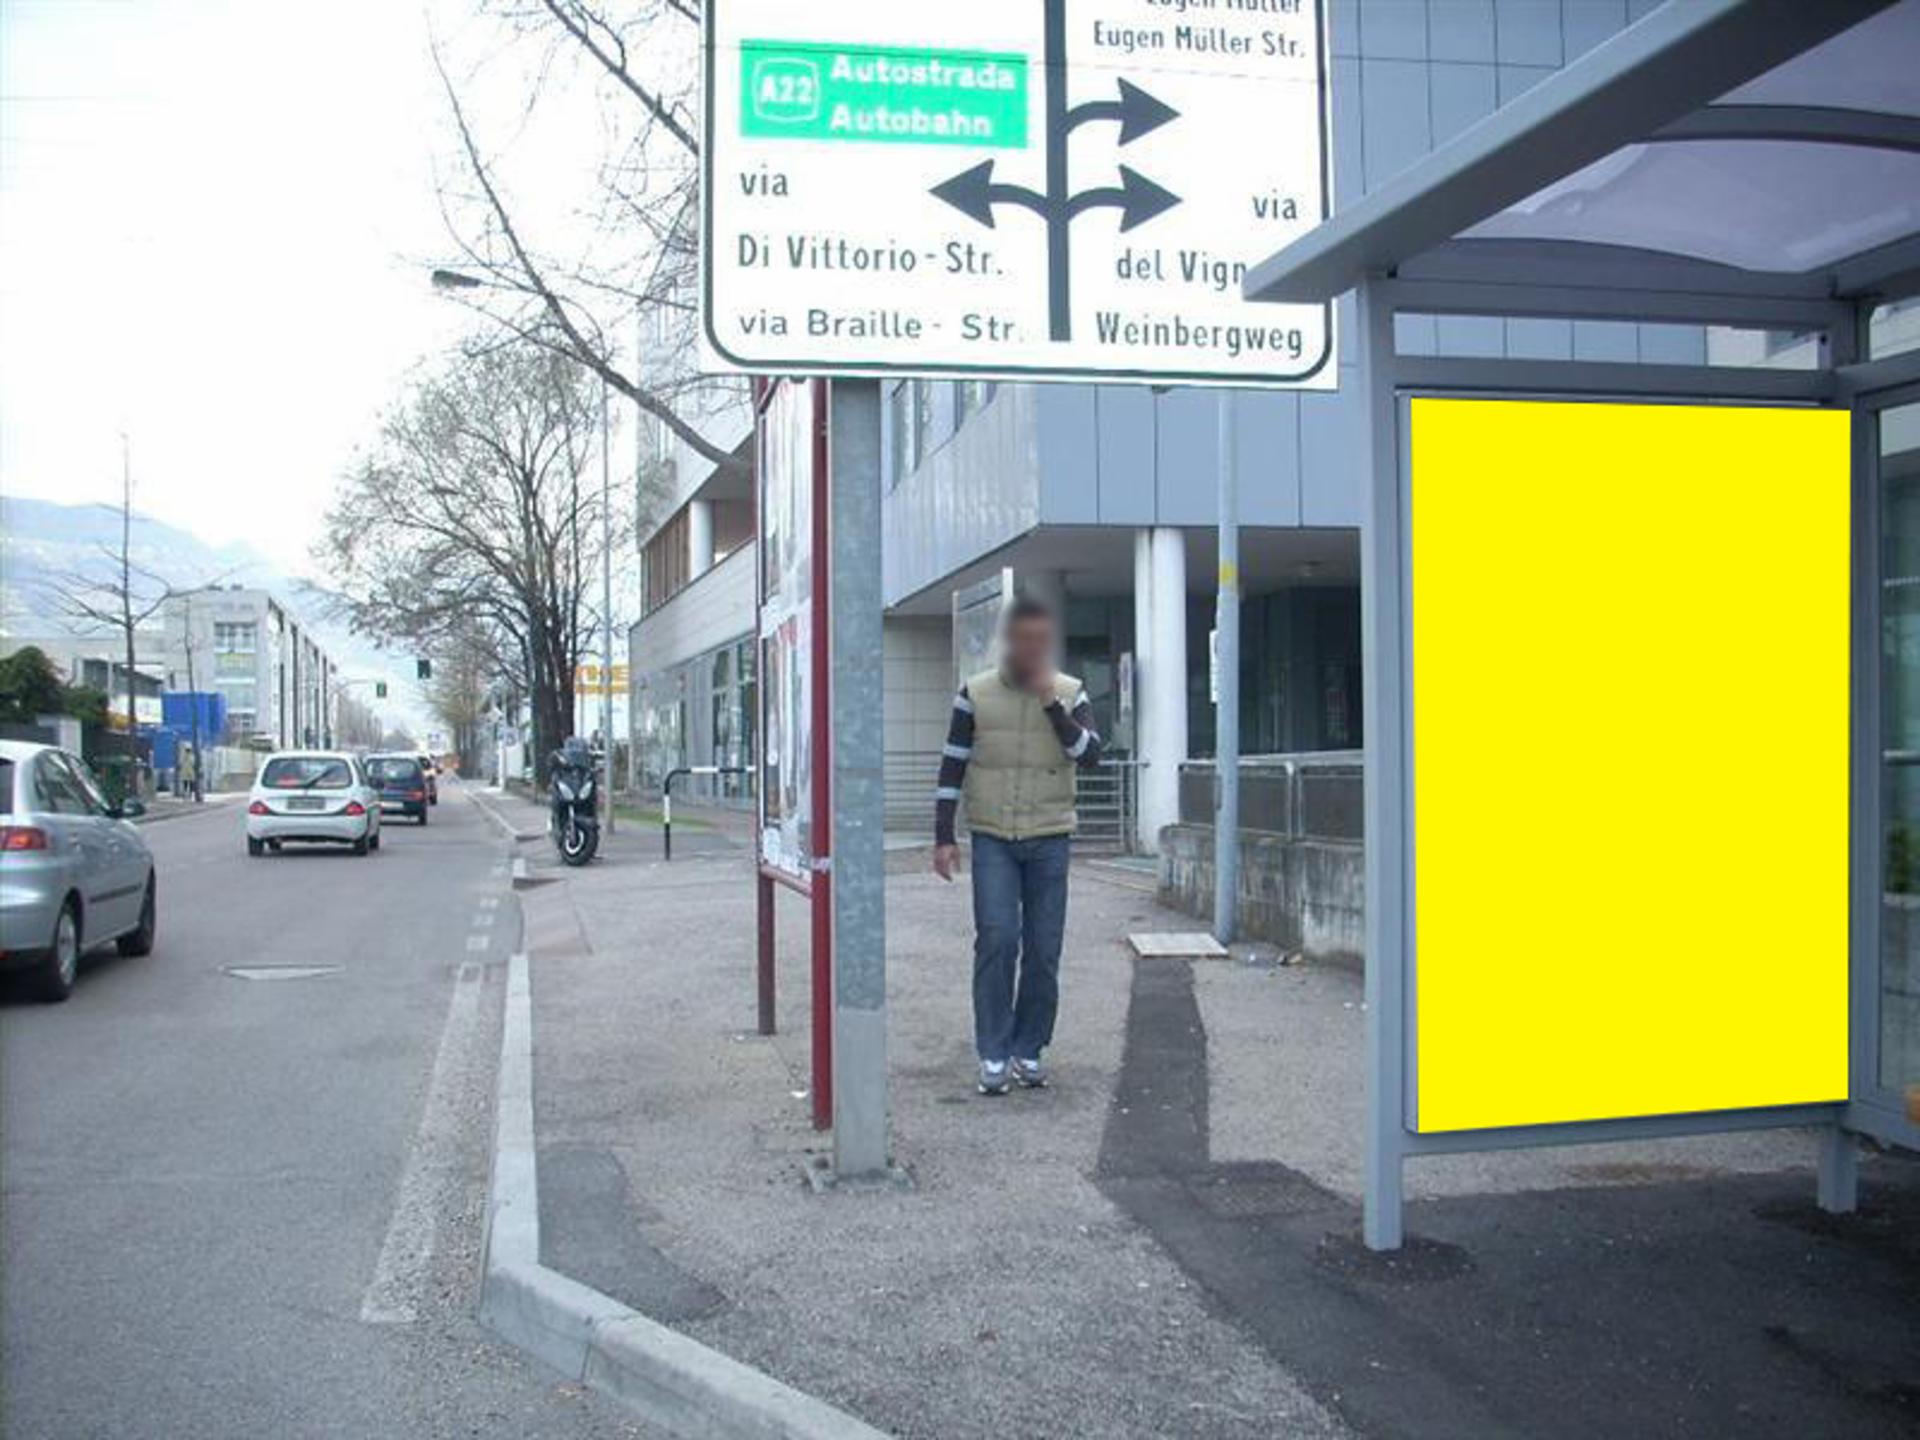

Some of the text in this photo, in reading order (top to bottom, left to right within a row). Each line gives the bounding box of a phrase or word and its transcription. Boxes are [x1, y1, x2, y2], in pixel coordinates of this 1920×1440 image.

[1093, 20, 1305, 58] Eugen Müller Str.
[830, 54, 1017, 90] Autostrada
[761, 75, 813, 104] A22
[830, 104, 993, 136] Autobahn
[739, 162, 789, 196] via
[1252, 188, 1299, 220] via
[738, 234, 769, 268] Di
[1116, 247, 1246, 292] del Vign
[739, 308, 788, 335] via
[1096, 311, 1303, 359] Weinbergweg
